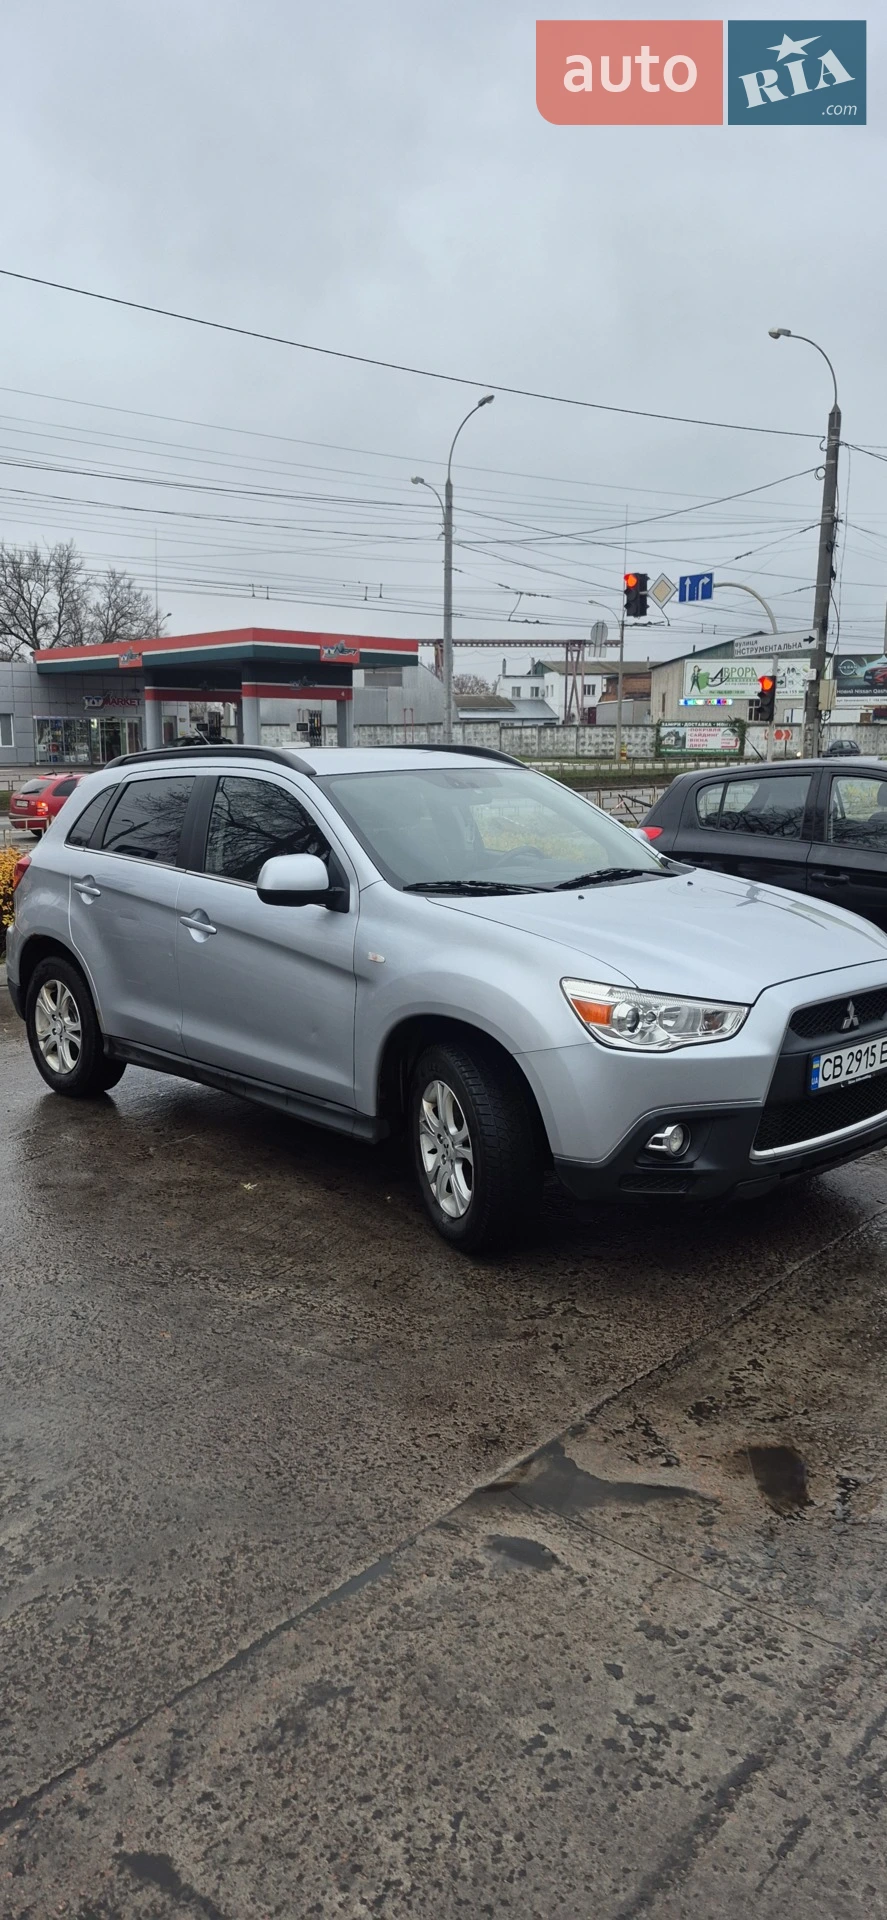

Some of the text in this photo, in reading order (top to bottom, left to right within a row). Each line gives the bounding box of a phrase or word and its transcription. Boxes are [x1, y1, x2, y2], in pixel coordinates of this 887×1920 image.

[735, 641, 803, 656] ІНСТРУМЕНТАЛЬНА
[711, 666, 758, 683] АВРОРА
[821, 1055, 843, 1082] CB
[845, 1044, 877, 1075] 2915
